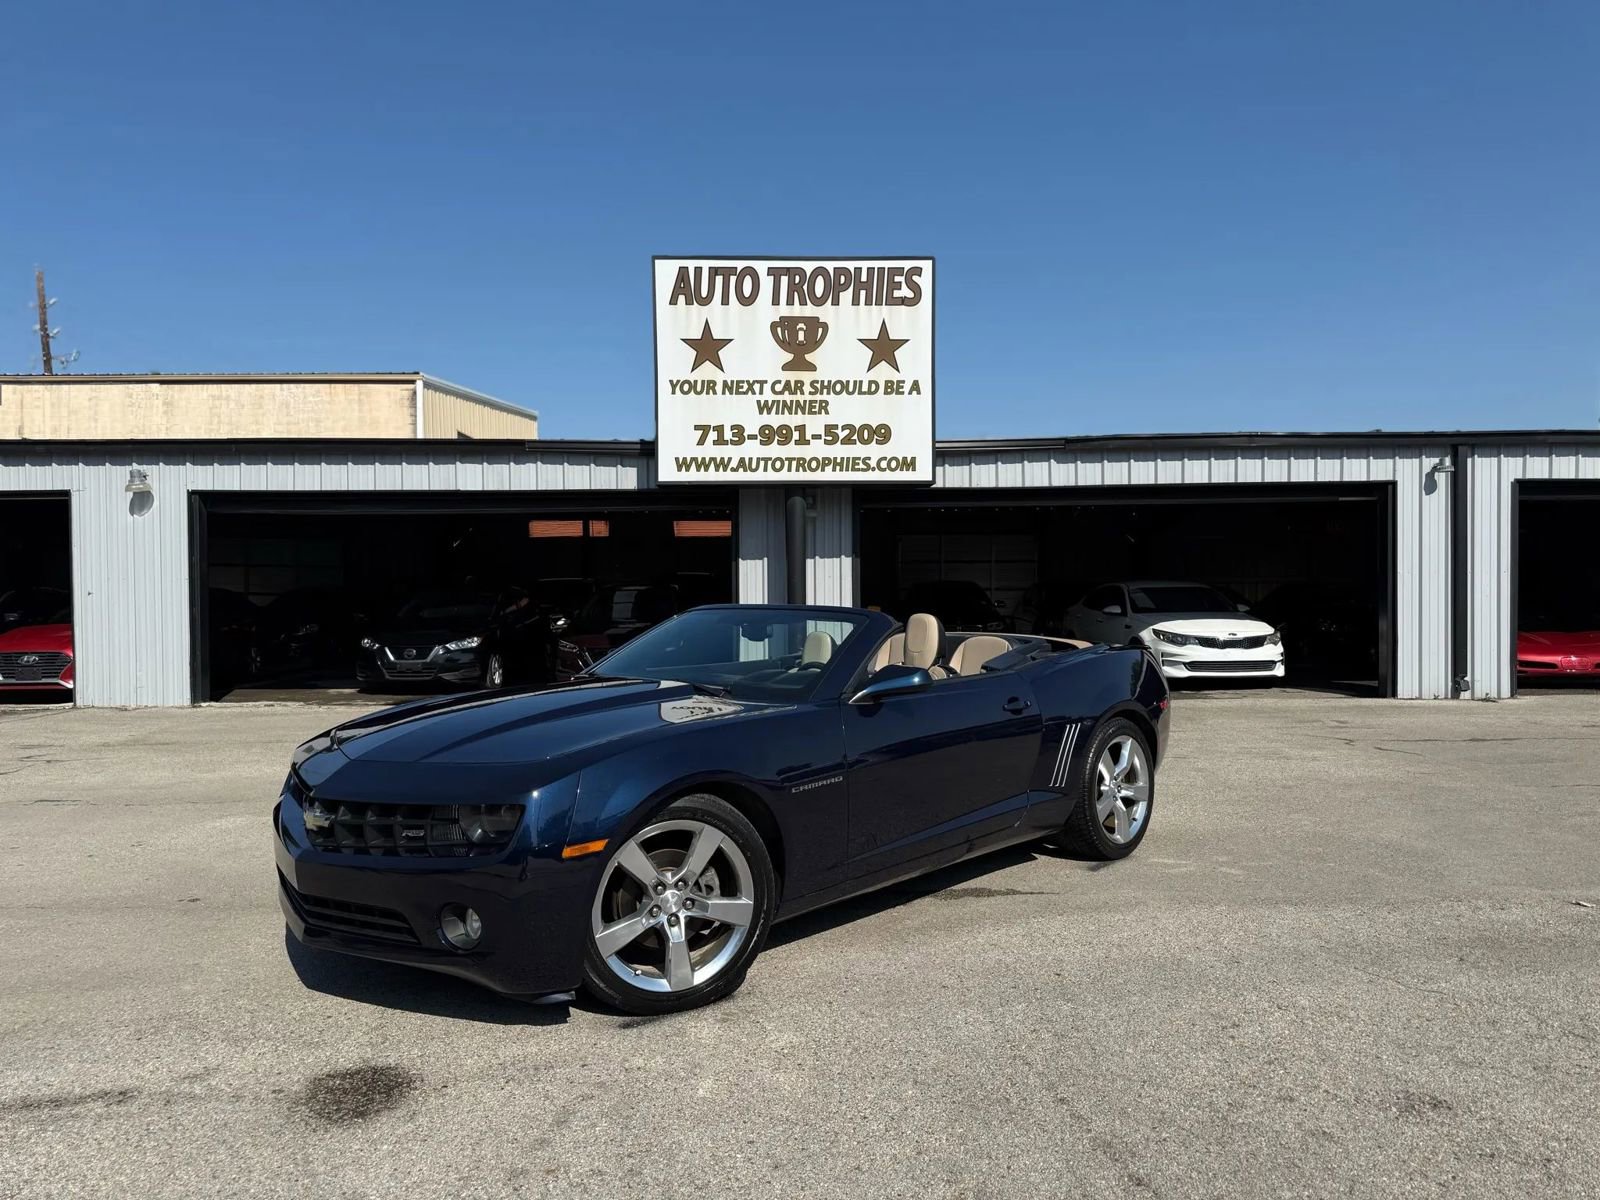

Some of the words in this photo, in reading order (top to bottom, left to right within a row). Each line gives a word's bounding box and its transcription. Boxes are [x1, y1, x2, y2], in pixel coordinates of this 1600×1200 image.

[668, 266, 760, 307] AUTO
[767, 266, 922, 307] TROPHIES
[669, 380, 717, 395] YOUR
[722, 380, 767, 395] NEXT
[771, 380, 804, 395] CAR
[809, 380, 879, 395] SHOULD
[884, 380, 905, 395] BE
[908, 380, 921, 395] A
[756, 400, 829, 415] WINNER
[694, 424, 892, 446] 713-991-5209
[675, 456, 917, 472] WWW.AUTOTROPHIES.COM
